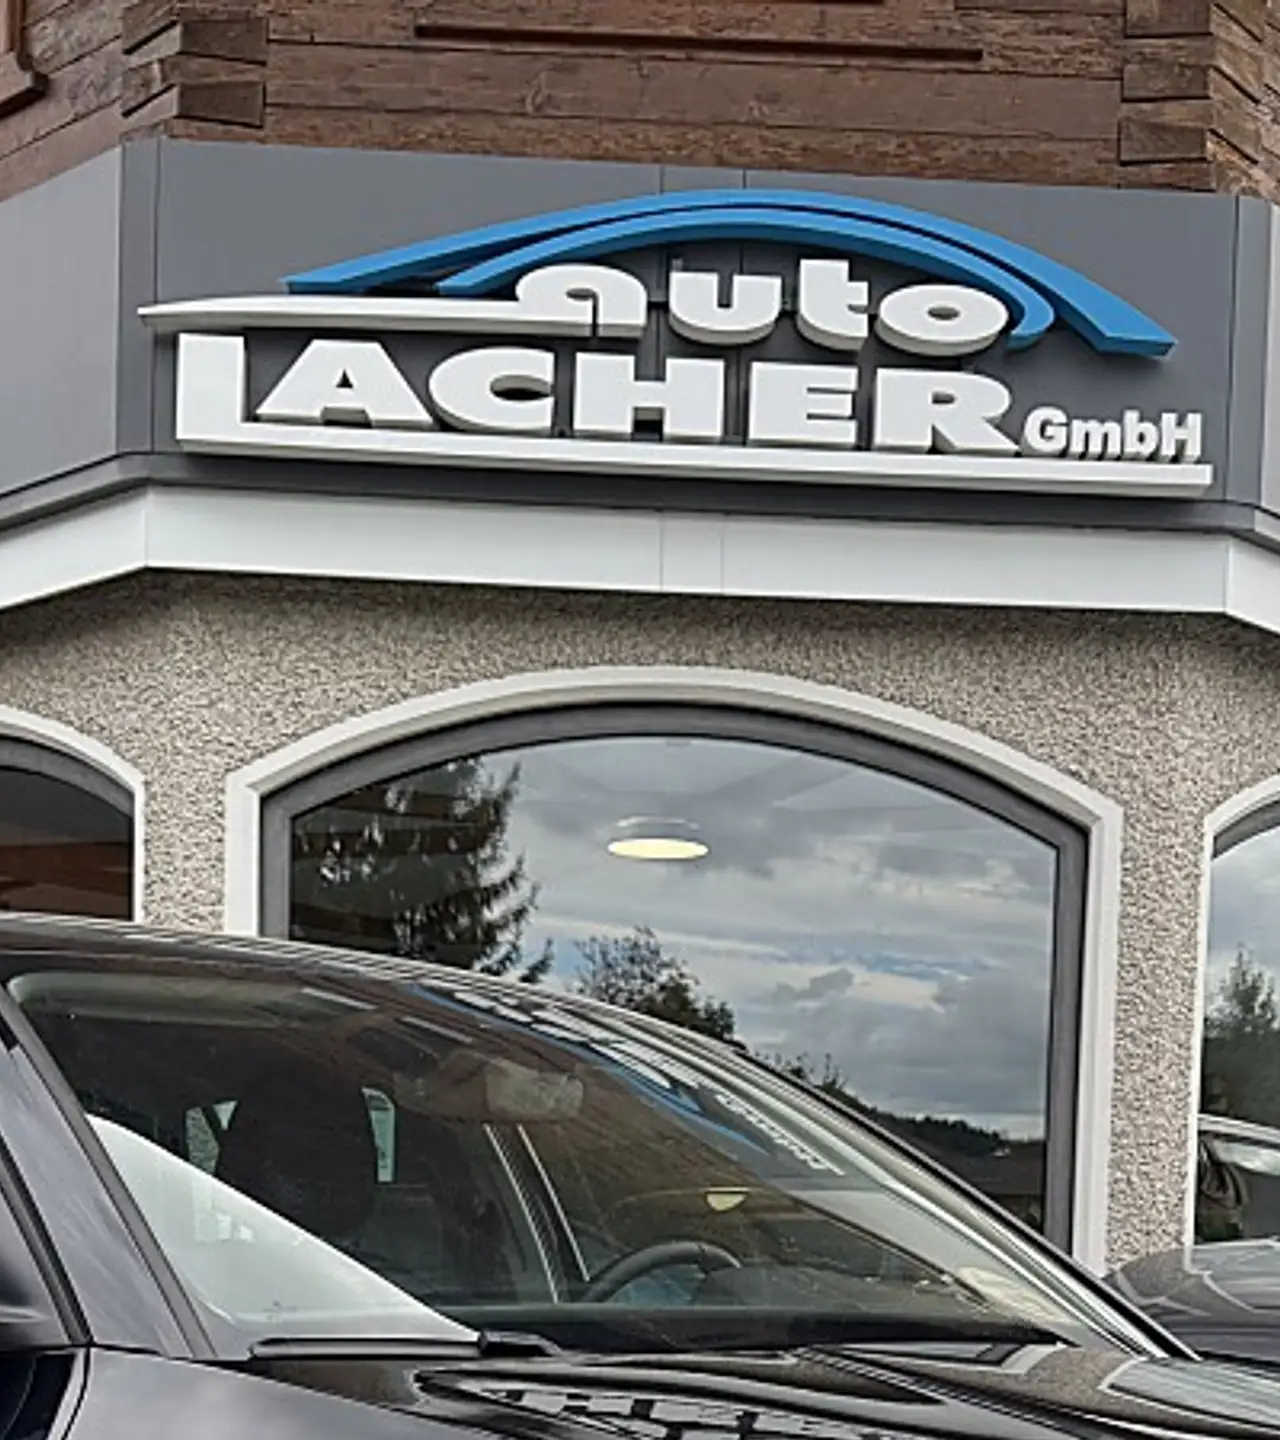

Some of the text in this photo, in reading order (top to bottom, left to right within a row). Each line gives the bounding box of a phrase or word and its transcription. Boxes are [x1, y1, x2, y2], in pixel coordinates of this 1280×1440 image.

[516, 258, 1010, 358] auto
[175, 332, 1204, 463] LACHER GmbH
